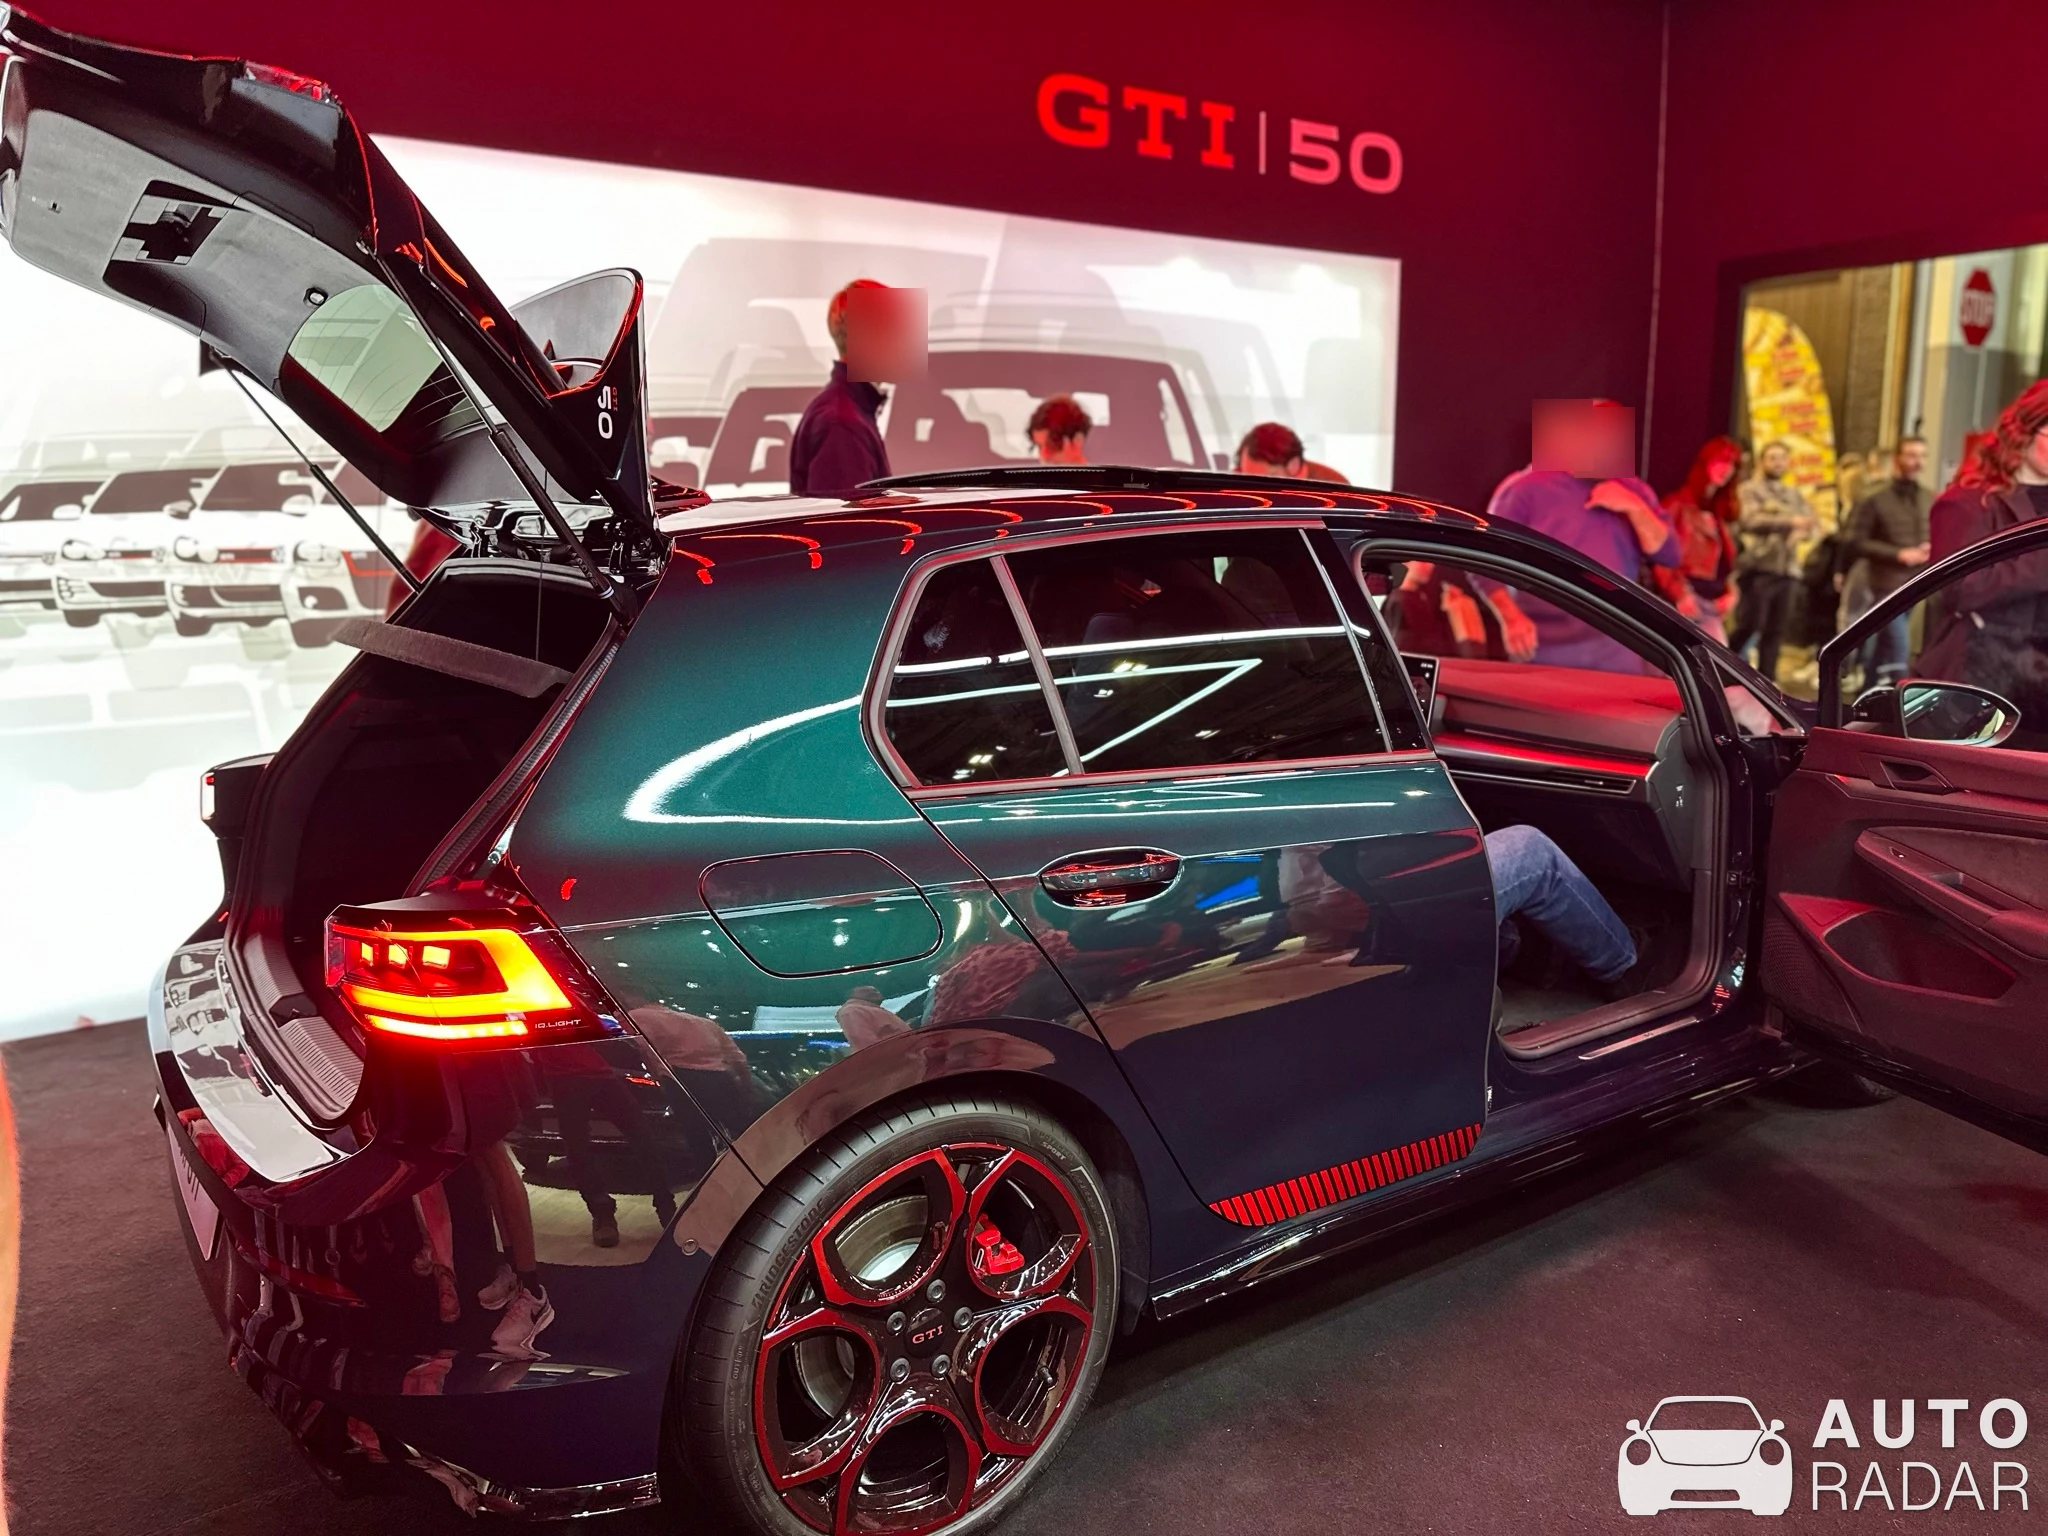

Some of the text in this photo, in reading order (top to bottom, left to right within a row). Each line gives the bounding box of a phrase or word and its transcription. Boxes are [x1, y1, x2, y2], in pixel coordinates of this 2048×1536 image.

[1037, 73, 1403, 194] GTI 50
[597, 385, 613, 440] 50
[534, 1019, 581, 1029] IQ.LIGHT
[1042, 1141, 1066, 1160] SPORT
[752, 1198, 826, 1309] BRIDGESTONE
[912, 1325, 943, 1344] GTI
